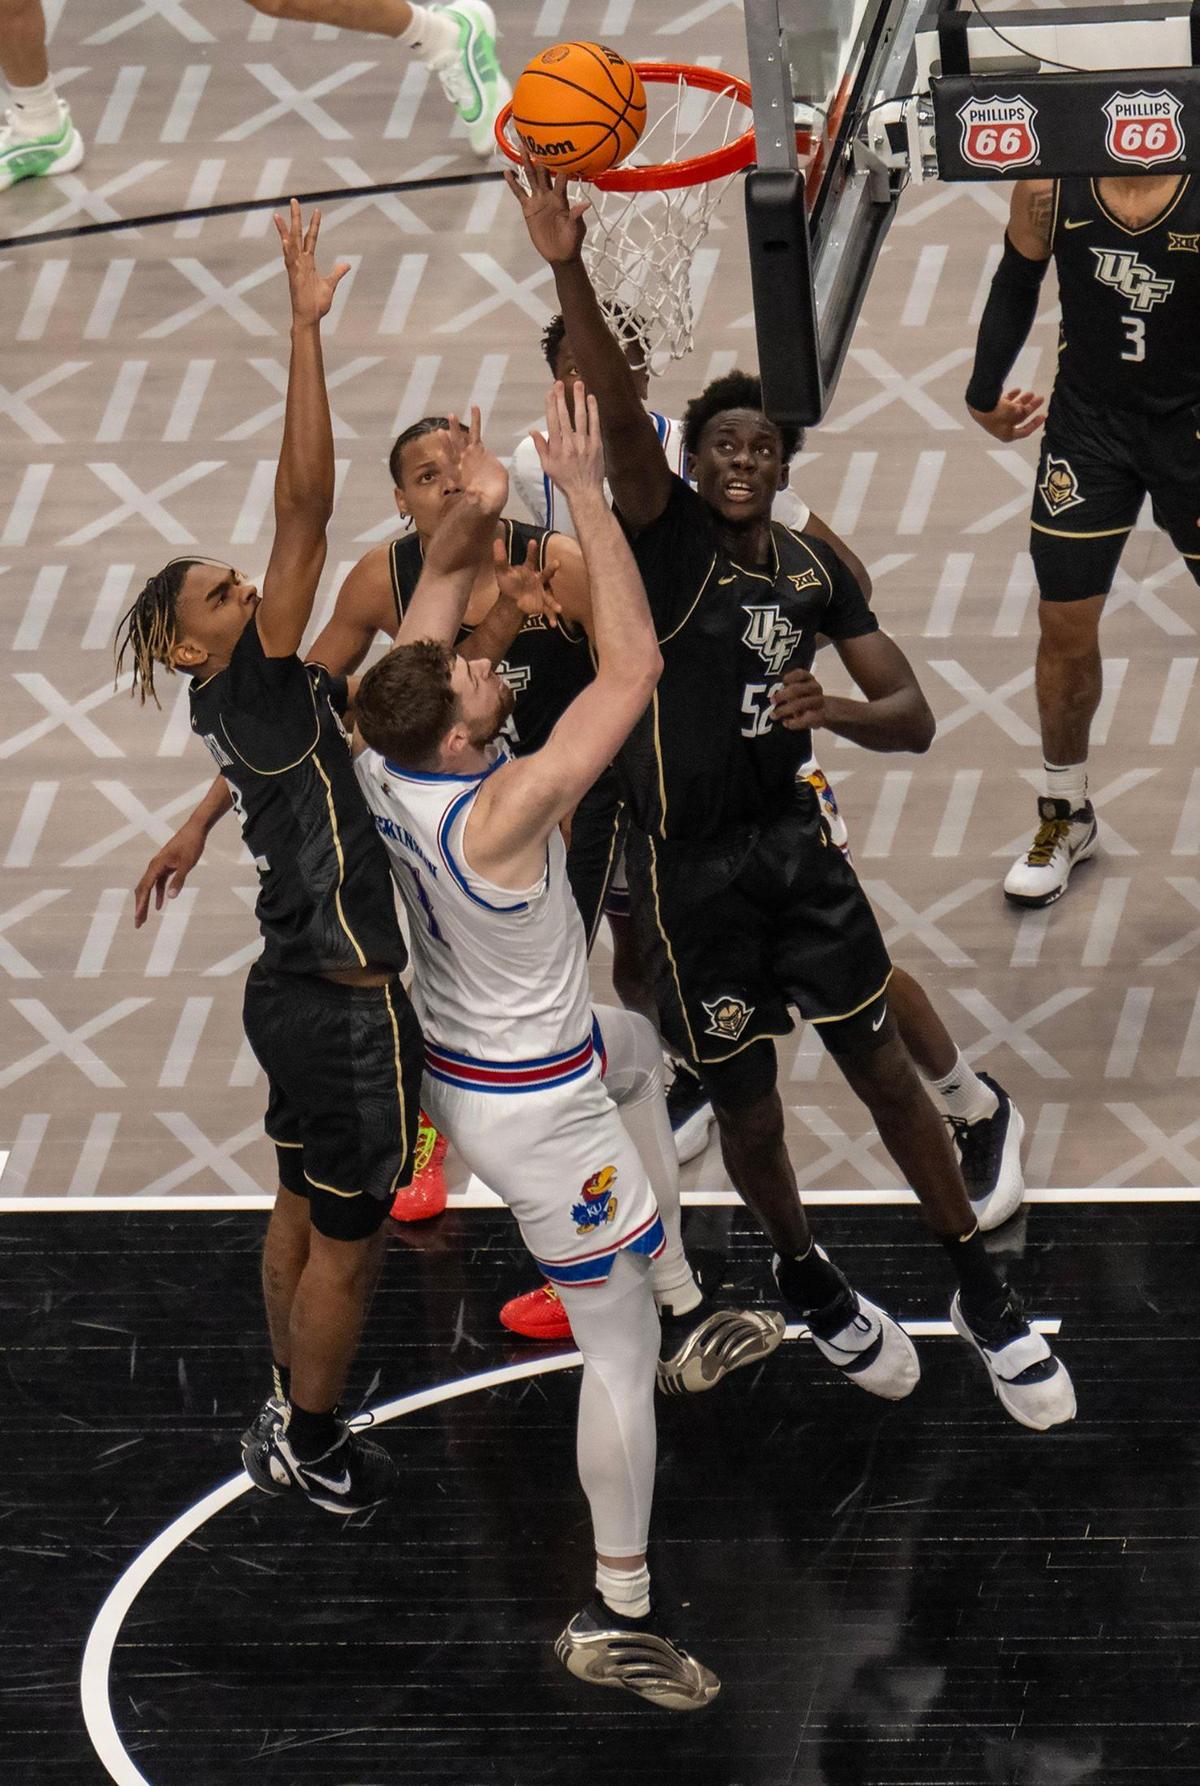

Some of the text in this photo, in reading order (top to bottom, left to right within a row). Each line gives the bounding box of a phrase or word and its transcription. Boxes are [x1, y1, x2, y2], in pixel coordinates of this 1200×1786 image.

[969, 107, 1025, 122] PHILLIPS
[1115, 102, 1171, 117] PHILLIPS
[517, 129, 577, 156] lson
[975, 128, 1022, 155] 66
[1121, 123, 1167, 150] 66
[1090, 248, 1174, 312] UCF
[1121, 316, 1146, 362] 3
[741, 605, 802, 676] UCF
[586, 1202, 602, 1217] KU
